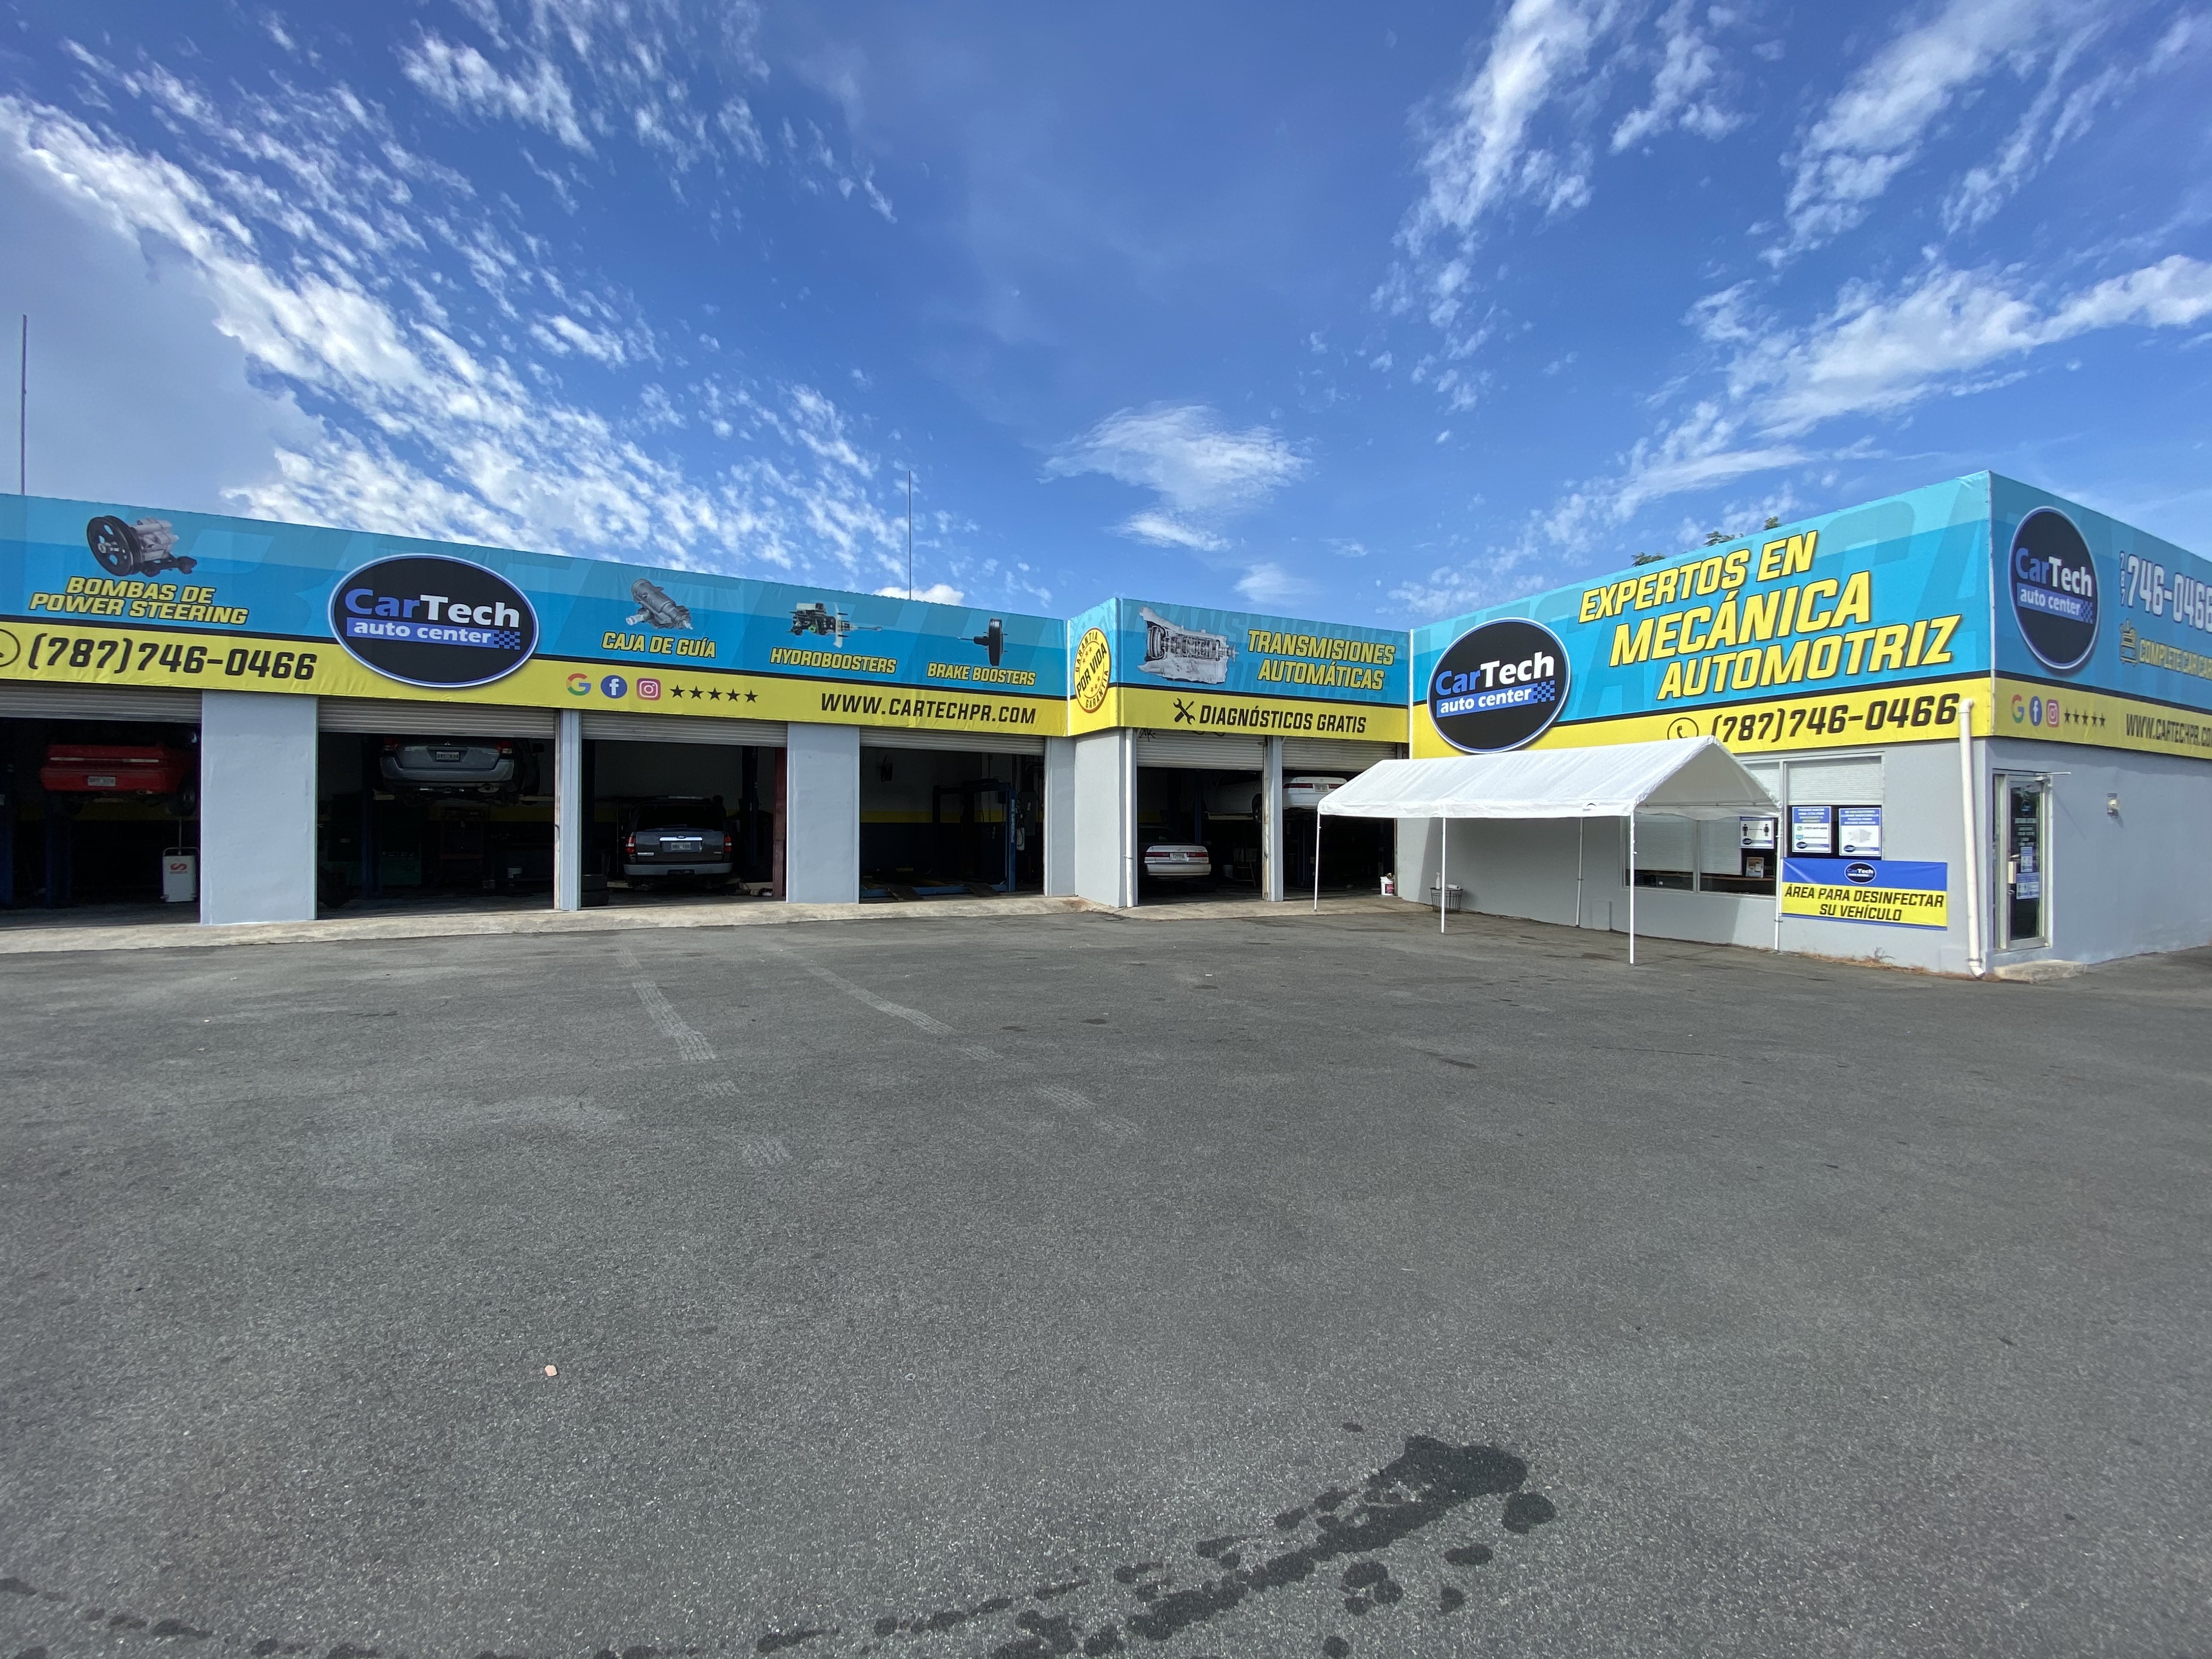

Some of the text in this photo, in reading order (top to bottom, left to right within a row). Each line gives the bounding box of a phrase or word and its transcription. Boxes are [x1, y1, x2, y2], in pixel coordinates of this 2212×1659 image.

[1578, 529, 1818, 624] EXPERTOS EN
[2015, 548, 2092, 597] CarTech
[65, 576, 216, 605] BOMBAS DE
[2020, 589, 2081, 616] auto center
[29, 592, 250, 625] POWER STEERING
[345, 588, 520, 628] CarTech
[1609, 570, 1872, 668] MECÁNICA
[354, 621, 491, 644] auto center
[601, 631, 716, 658] CAJA DE GUÍA
[1248, 629, 1396, 665] TRANSMISIONES
[28, 633, 318, 680] (787)746-0466
[770, 647, 898, 674] HYDROBOOSTERS
[1076, 642, 1107, 698] POR VIDA
[1656, 614, 1963, 701] AUTOMOTRIZ
[927, 662, 1036, 686] BRAKE BOOSTERS
[1257, 658, 1385, 690] AUTOMÁTICAS
[1436, 651, 1555, 696] CarTech
[821, 692, 1036, 724] WWW.CARTECHPR.COM
[1440, 687, 1532, 714] auto center
[1199, 704, 1367, 733] DIAGNÓSTICOS GRATIS
[1711, 692, 1960, 743] (787)746-0466
[1784, 883, 1945, 907] ÁREA PARA DESINFECTAR
[1819, 904, 1902, 921] SU VEHÍCULO
